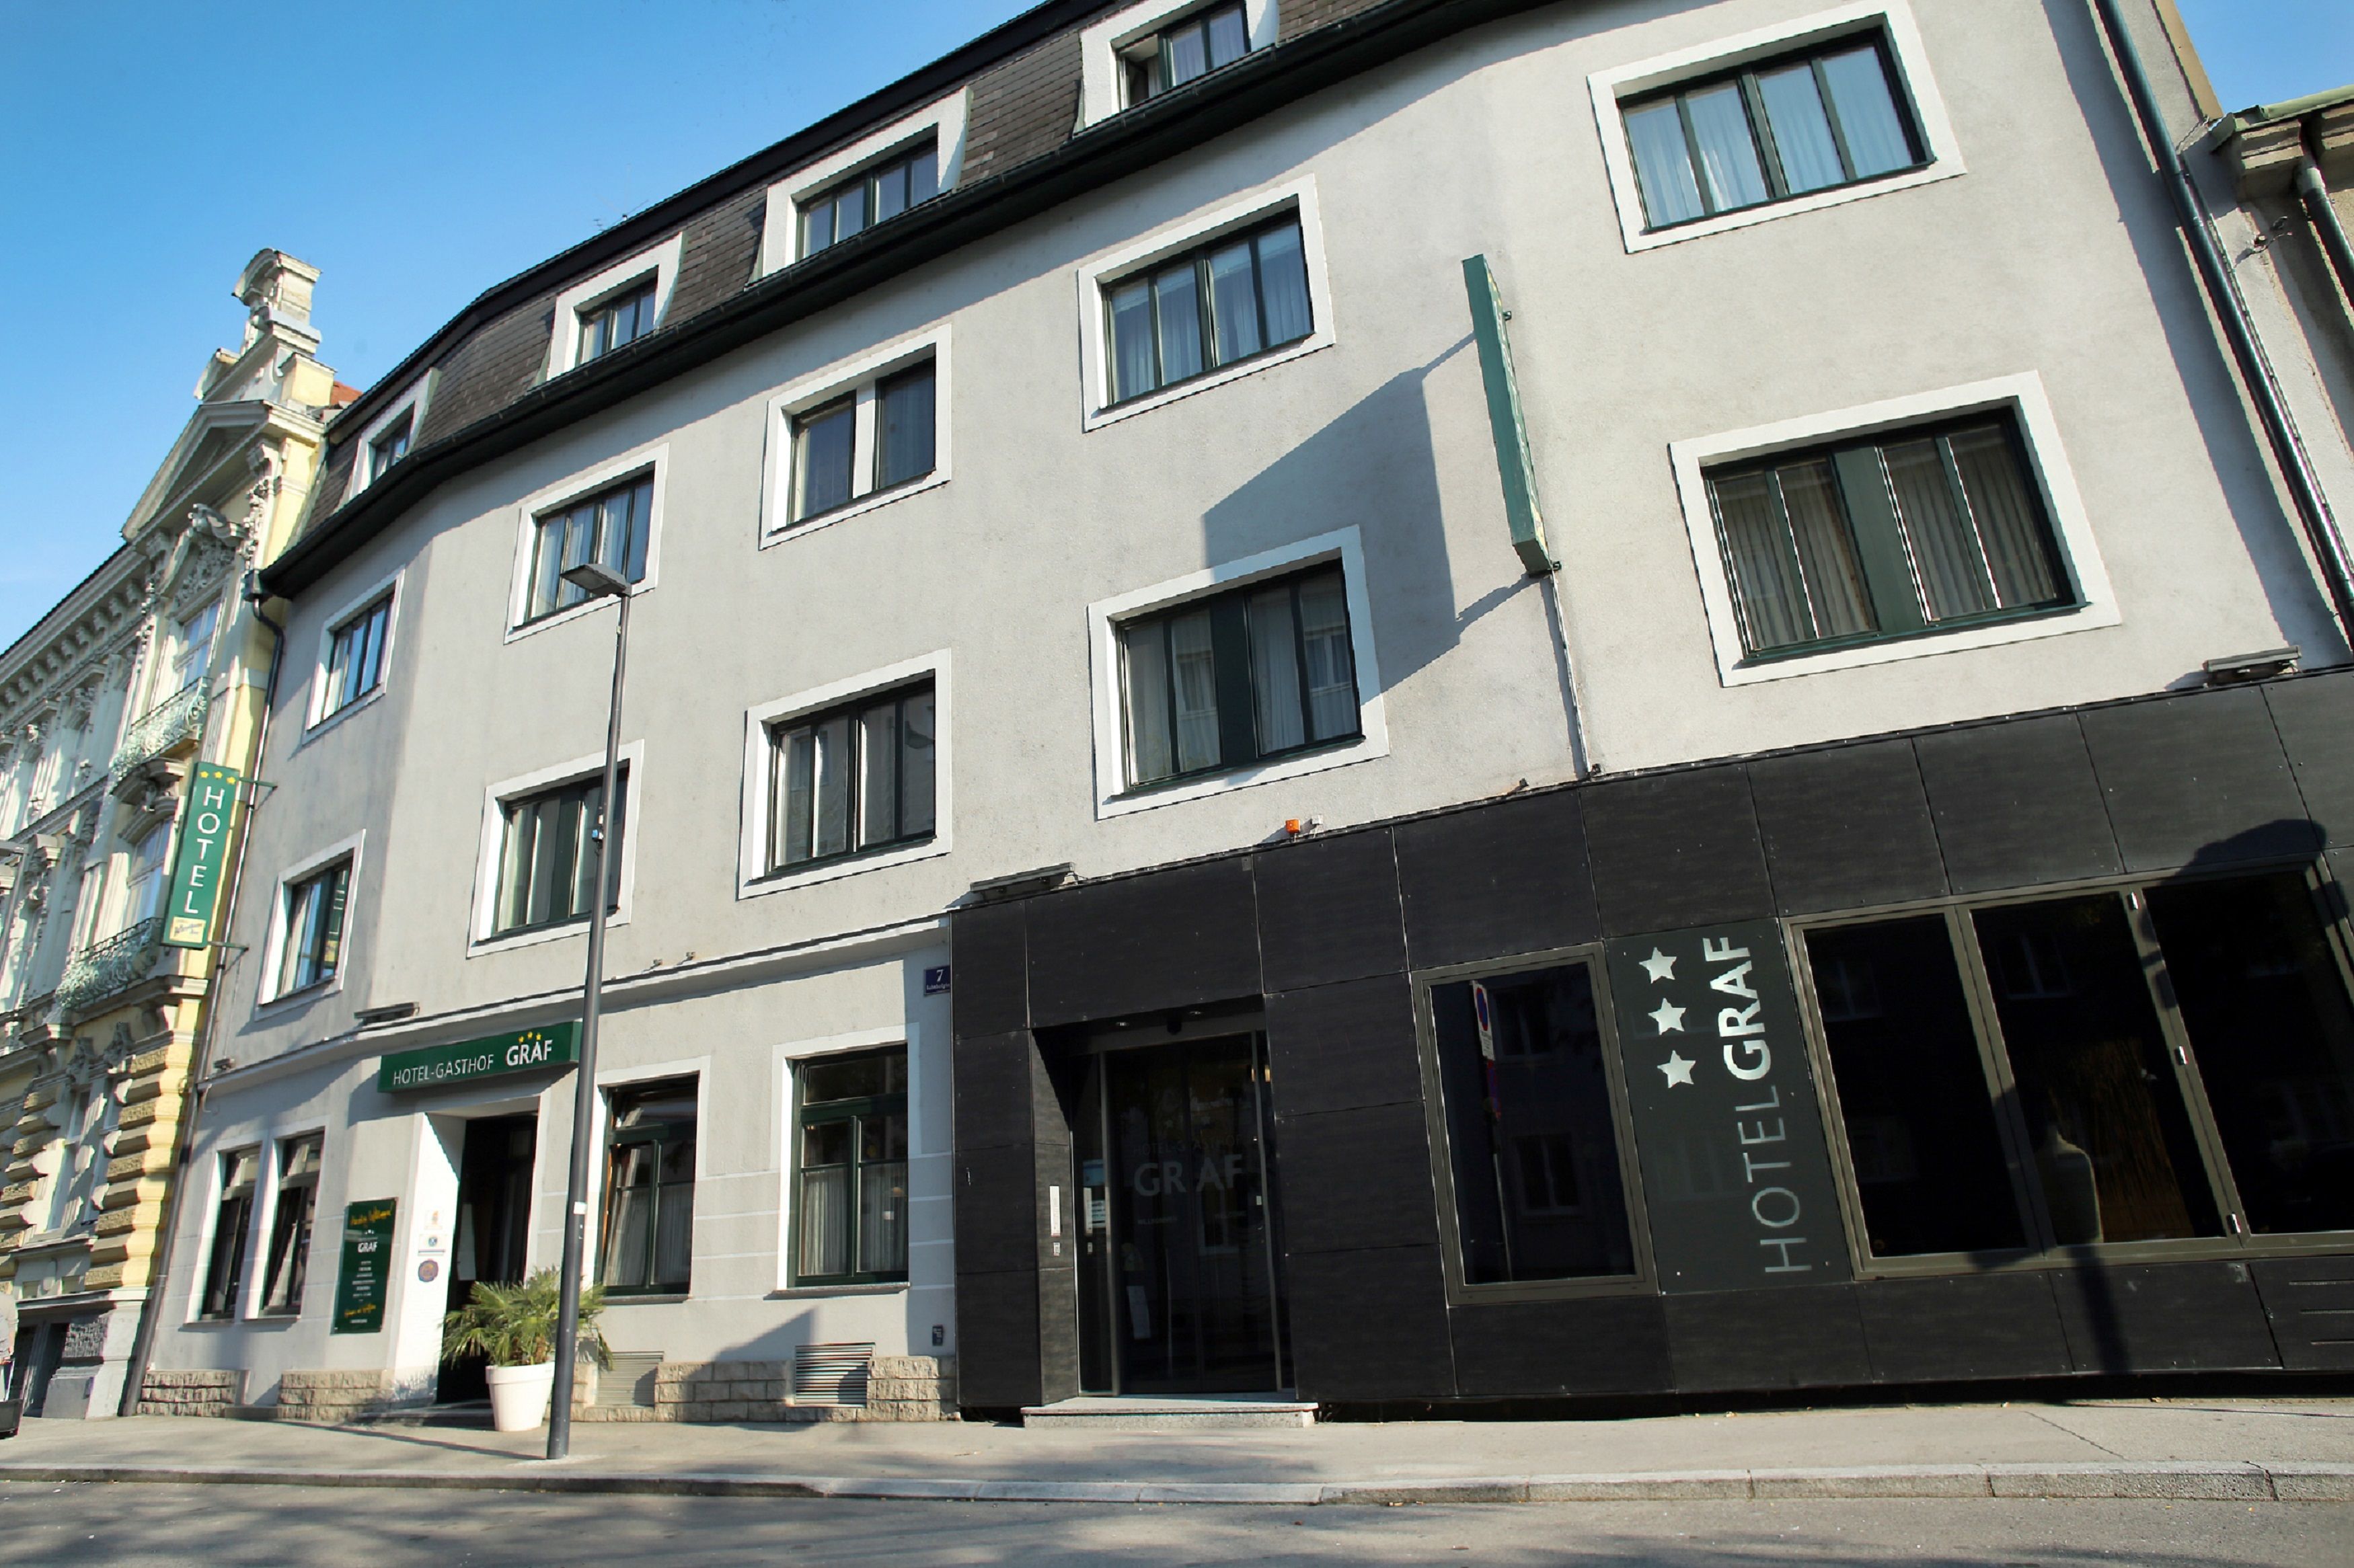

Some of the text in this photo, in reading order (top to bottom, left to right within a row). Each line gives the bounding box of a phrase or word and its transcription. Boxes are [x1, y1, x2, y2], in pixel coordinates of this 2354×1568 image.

[184, 785, 225, 914] HOTEL
[936, 969, 944, 982] 7
[393, 1039, 553, 1086] HOTEL-GASTHOF GRAF
[1702, 937, 1813, 1273] HOTEL GRAF
[357, 1241, 378, 1253] GRAF
